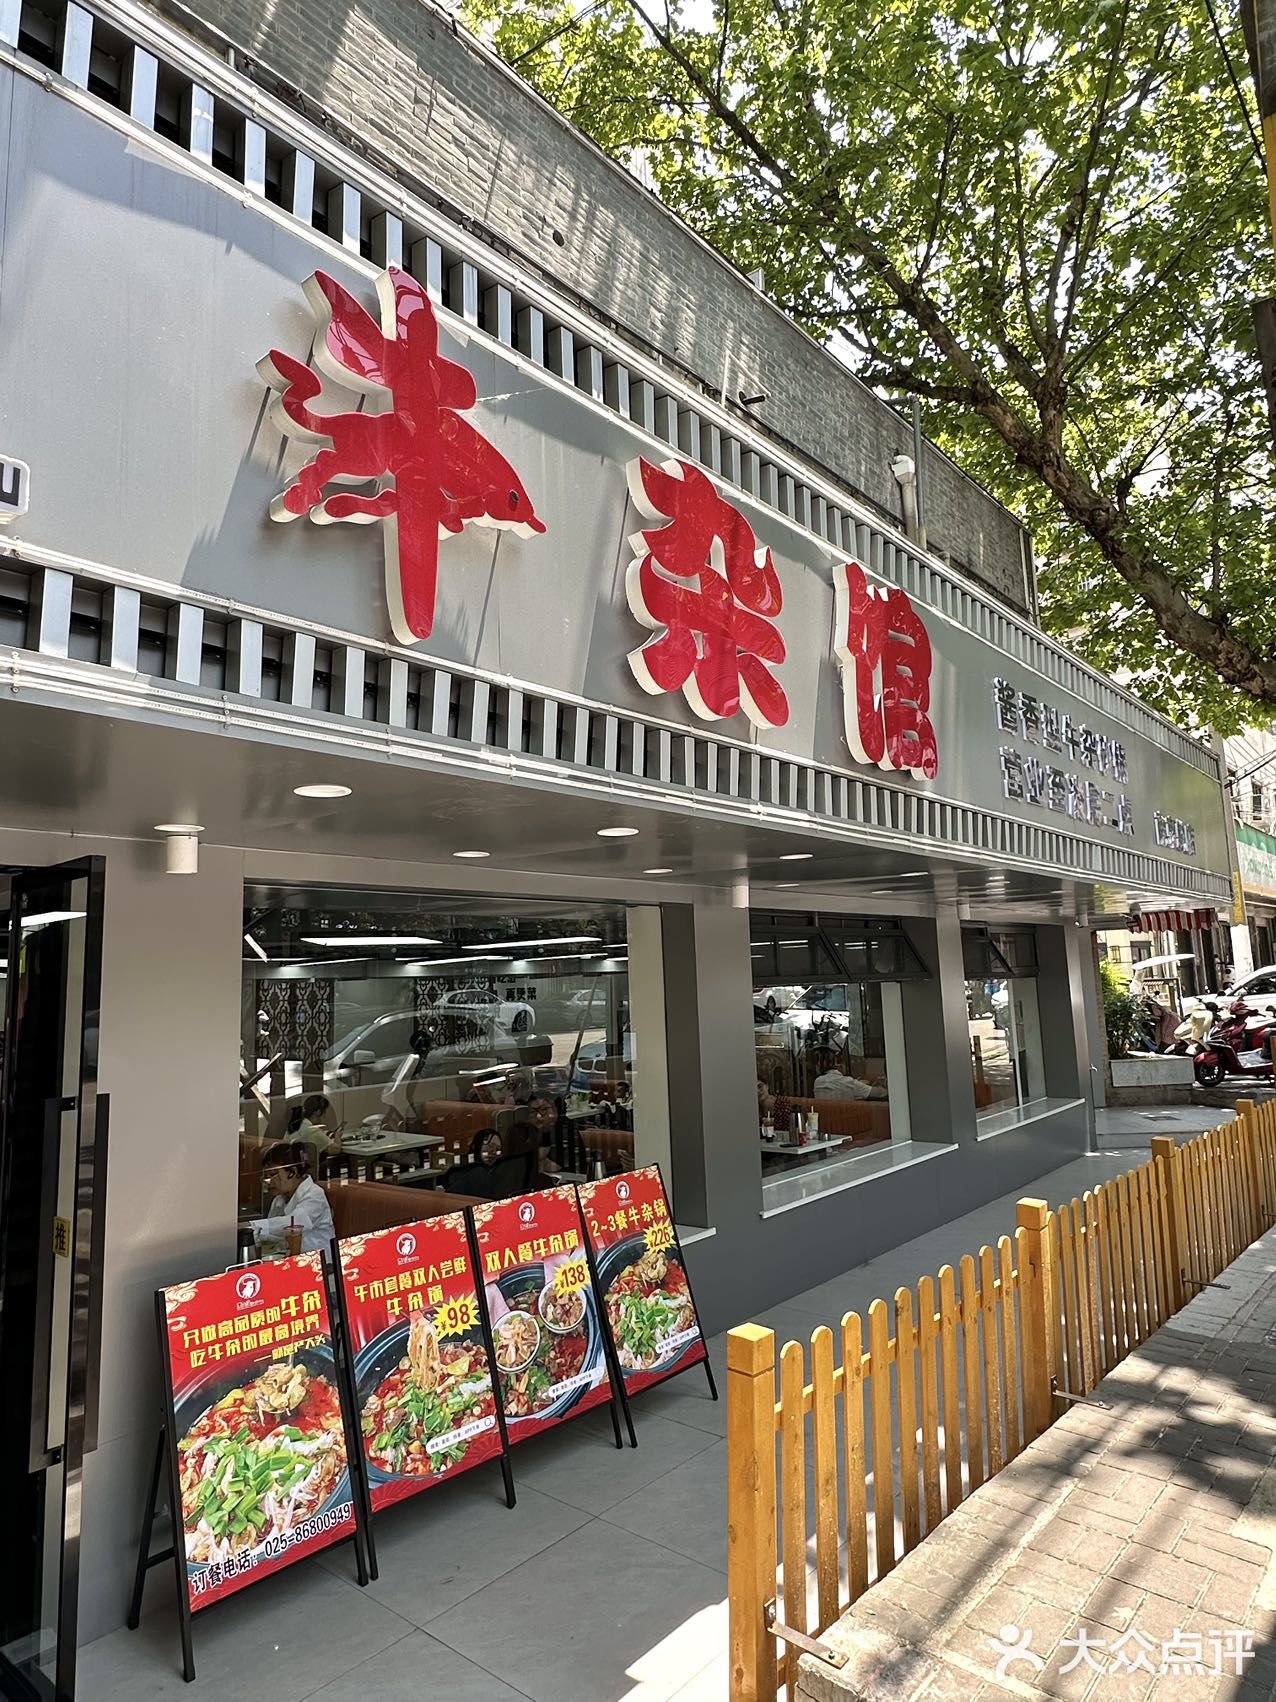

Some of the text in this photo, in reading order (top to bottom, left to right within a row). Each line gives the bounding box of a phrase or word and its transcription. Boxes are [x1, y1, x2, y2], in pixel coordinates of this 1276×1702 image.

[55, 1222, 66, 1251] 推
[485, 1229, 579, 1273] 双人餐牛杂锅
[354, 1256, 467, 1303] 午市套餐双人尝鲜
[387, 1285, 444, 1316] 牛杂锅
[184, 1290, 322, 1348] 只做高品质的牛杂
[190, 1314, 320, 1368] 吃牛杂的最高境界
